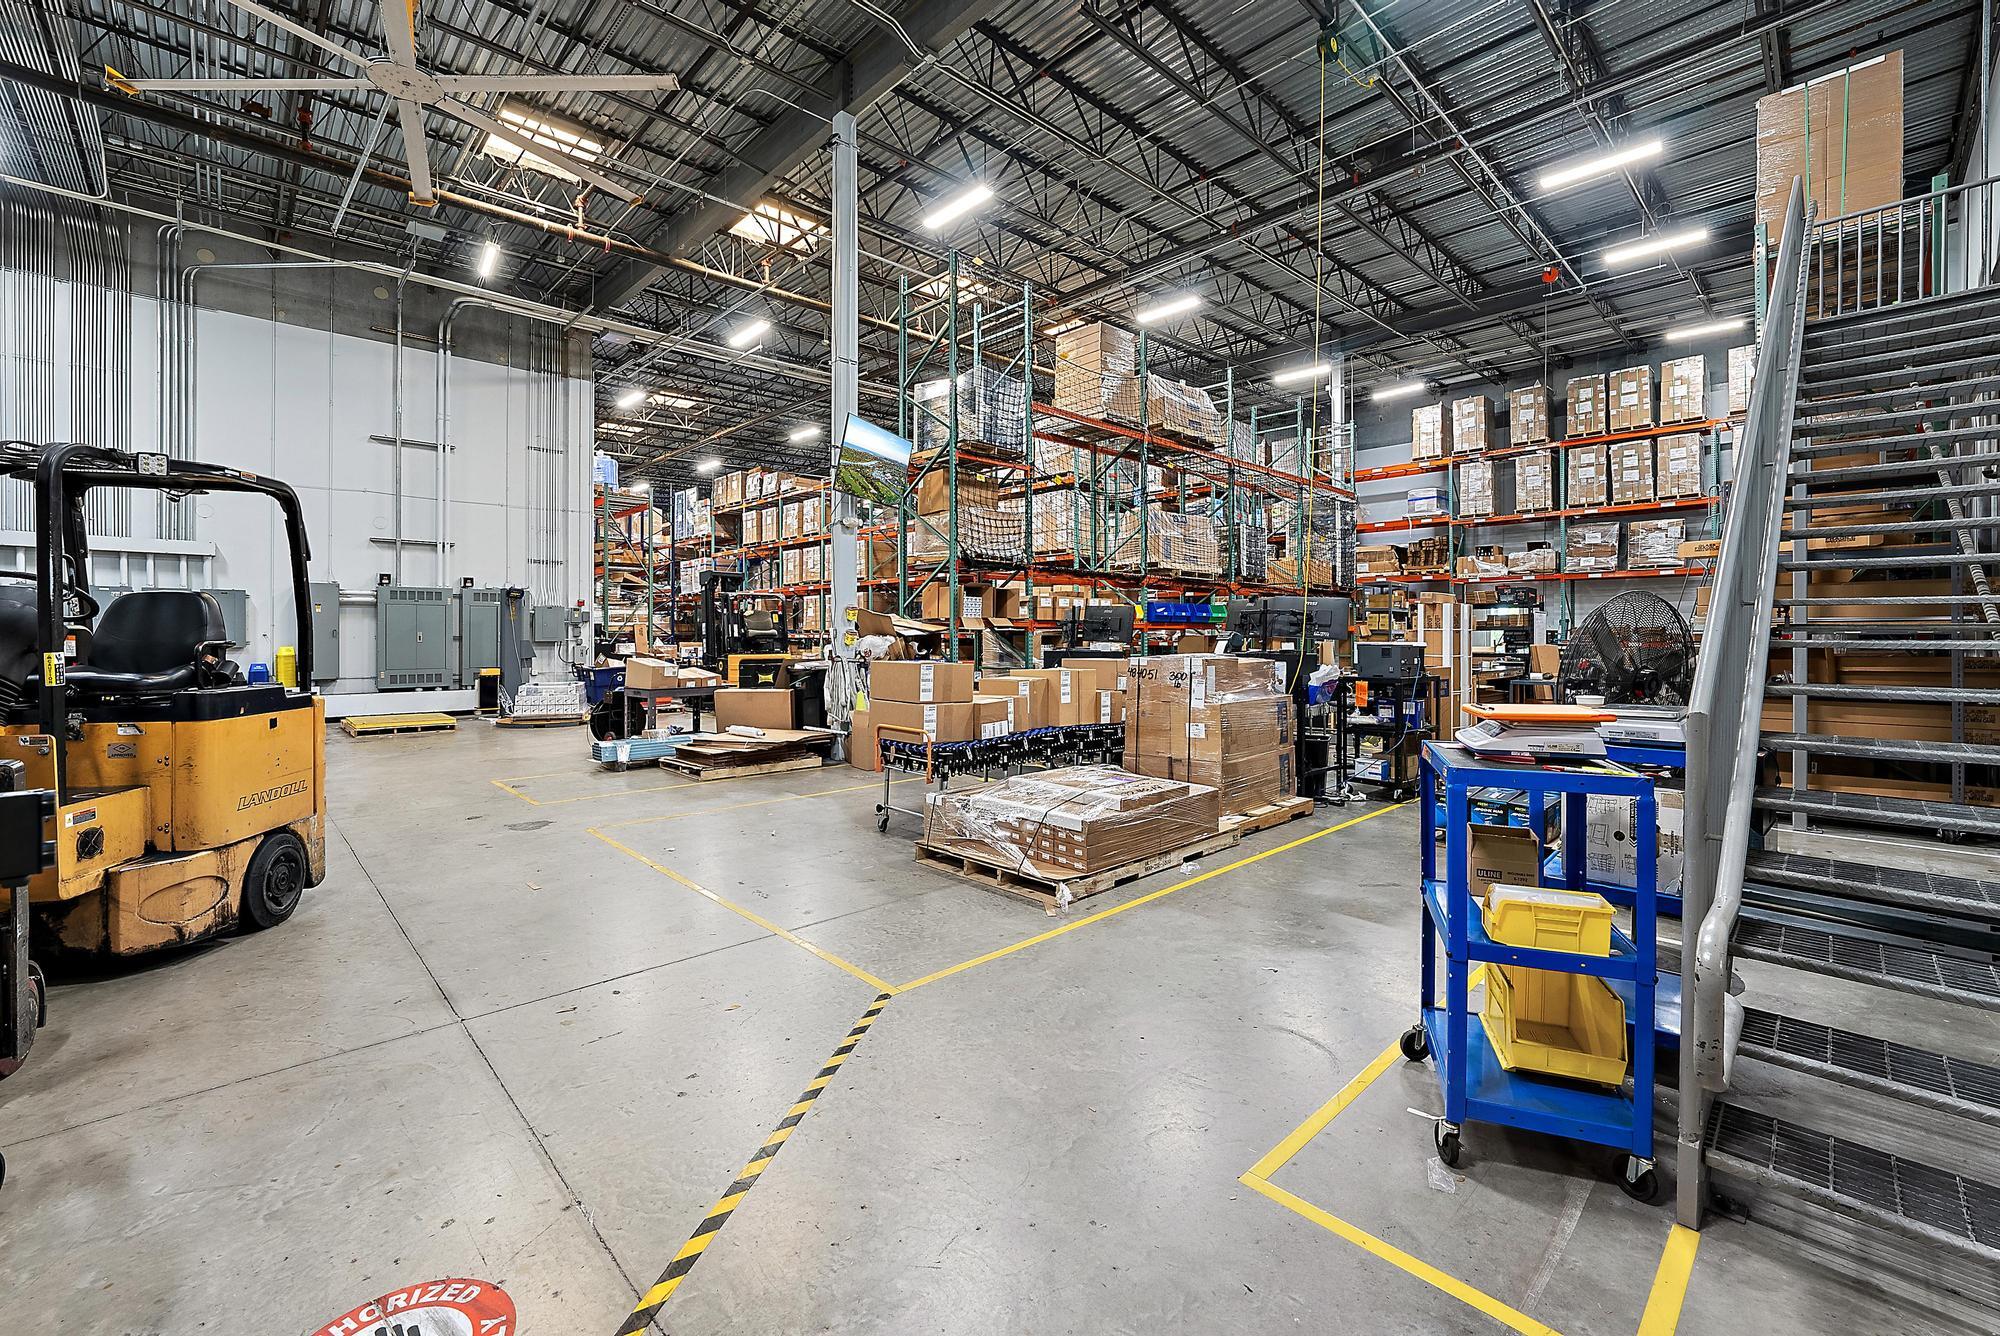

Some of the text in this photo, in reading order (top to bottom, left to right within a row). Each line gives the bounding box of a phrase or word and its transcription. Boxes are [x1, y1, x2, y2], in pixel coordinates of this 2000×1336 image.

[236, 779, 309, 811] LANDOLL
[1477, 869, 1502, 879] ULINE
[326, 1283, 482, 1336] HORIZED
